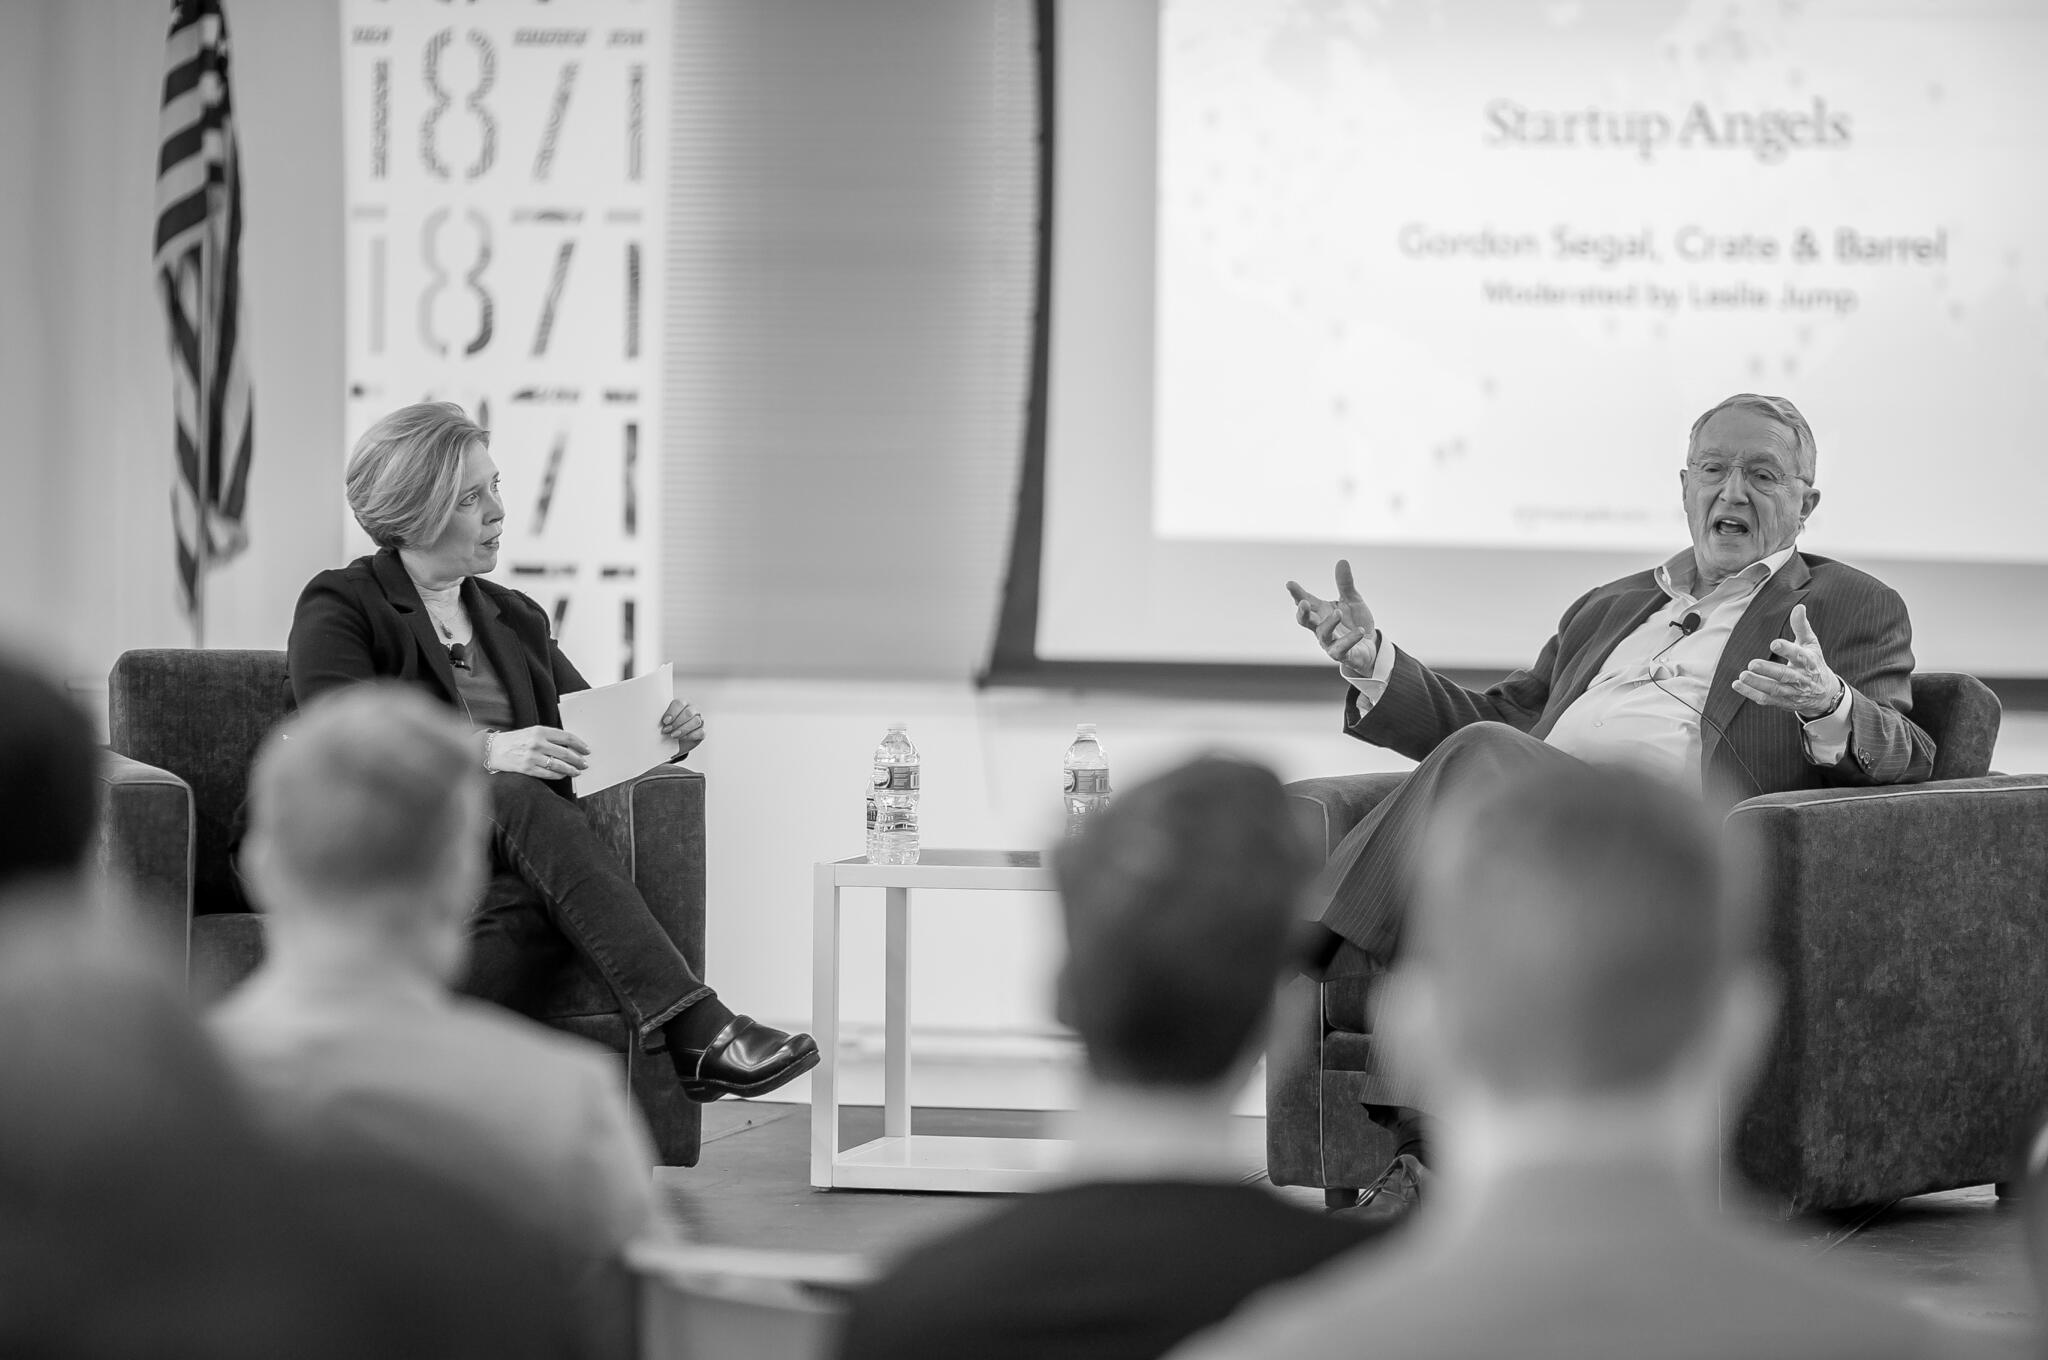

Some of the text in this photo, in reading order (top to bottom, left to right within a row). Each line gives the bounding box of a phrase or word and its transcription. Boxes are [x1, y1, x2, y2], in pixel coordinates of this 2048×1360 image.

[351, 26, 648, 183] 1871
[1484, 96, 1852, 163] Startup Angels
[1400, 222, 1539, 258] Gordon
[1675, 224, 1780, 261] Crate
[1792, 226, 1820, 263] &
[1835, 226, 1947, 264] Barrel
[350, 206, 644, 358] 1871
[1646, 282, 1678, 314] by
